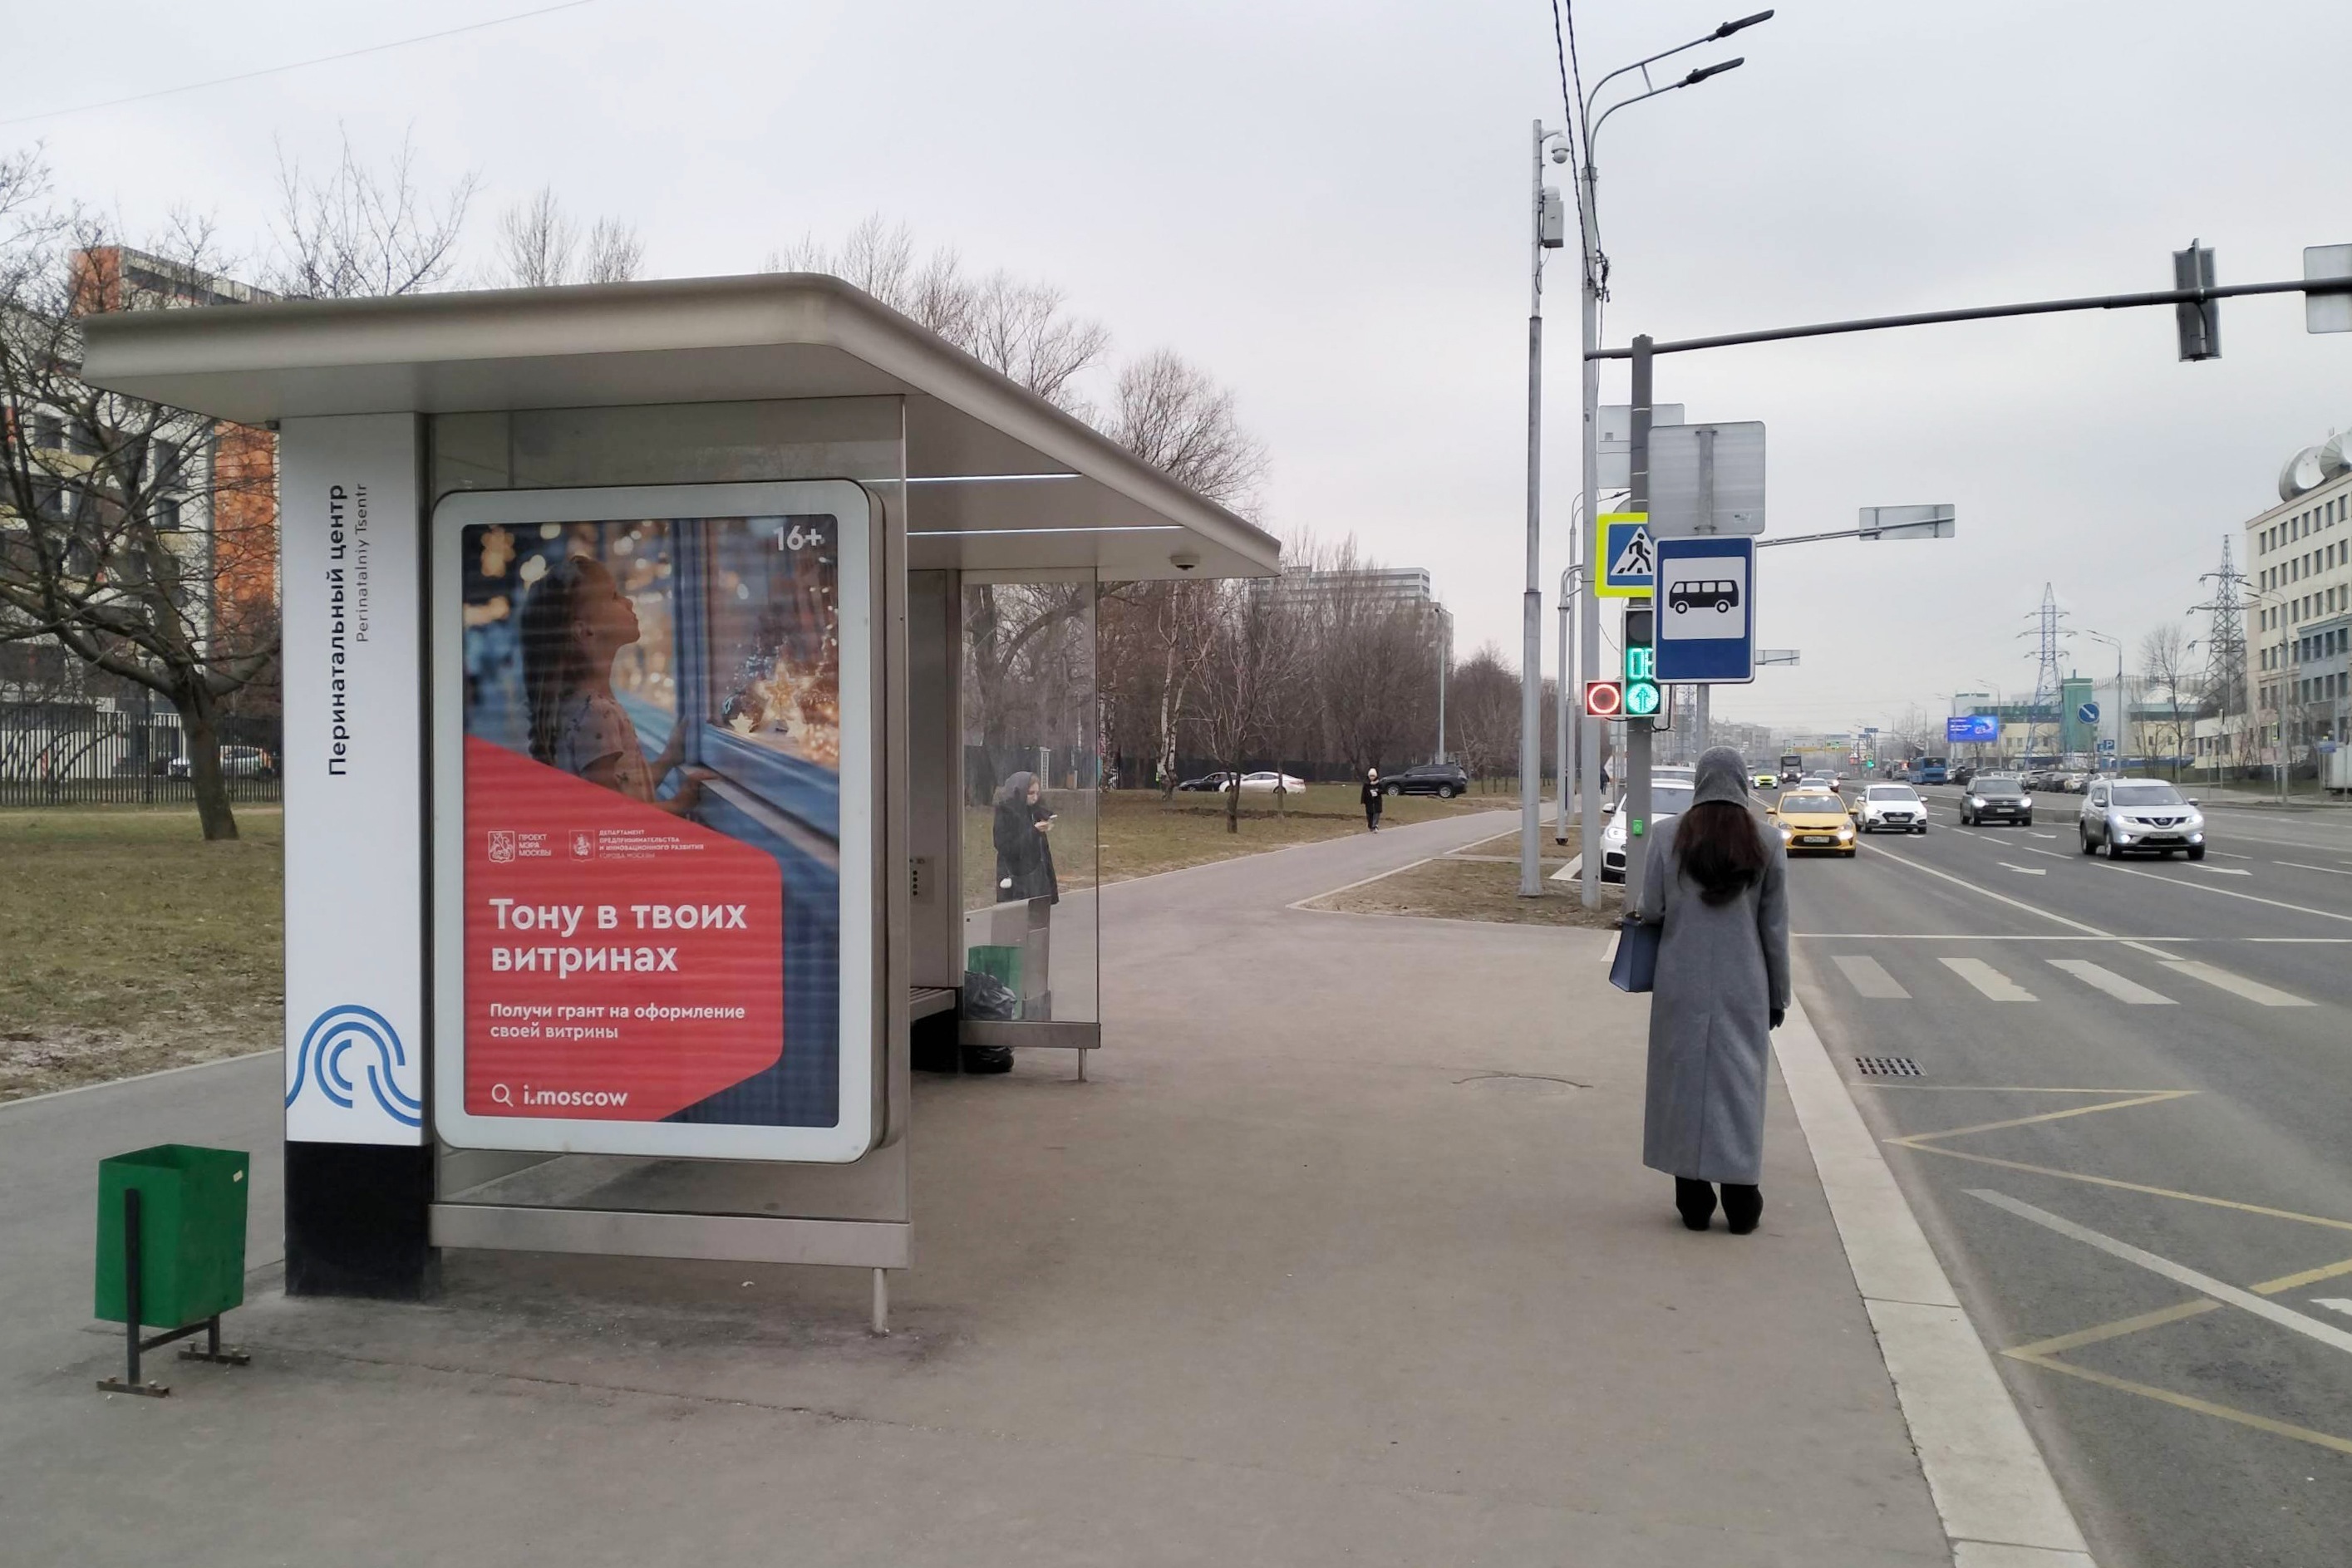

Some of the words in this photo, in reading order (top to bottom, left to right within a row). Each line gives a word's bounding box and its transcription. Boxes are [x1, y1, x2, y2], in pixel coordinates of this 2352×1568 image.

[330, 484, 348, 560] центр
[355, 484, 367, 534] Tsentr
[773, 524, 822, 551] 16+
[355, 538, 370, 642] Perinatalniy
[326, 568, 350, 775] Перинатальный
[519, 833, 547, 842] ПРОЕКТ
[490, 898, 583, 937] Тону
[597, 905, 618, 929] в
[631, 904, 747, 929] твоих
[491, 947, 678, 979] витринах
[490, 1004, 553, 1020] Получи
[558, 1006, 605, 1020] грант
[610, 1006, 629, 1018] на
[634, 1004, 745, 1020] оформление
[490, 1022, 540, 1038] своей
[545, 1025, 618, 1040] витрины
[523, 1085, 628, 1106] i.moscow
